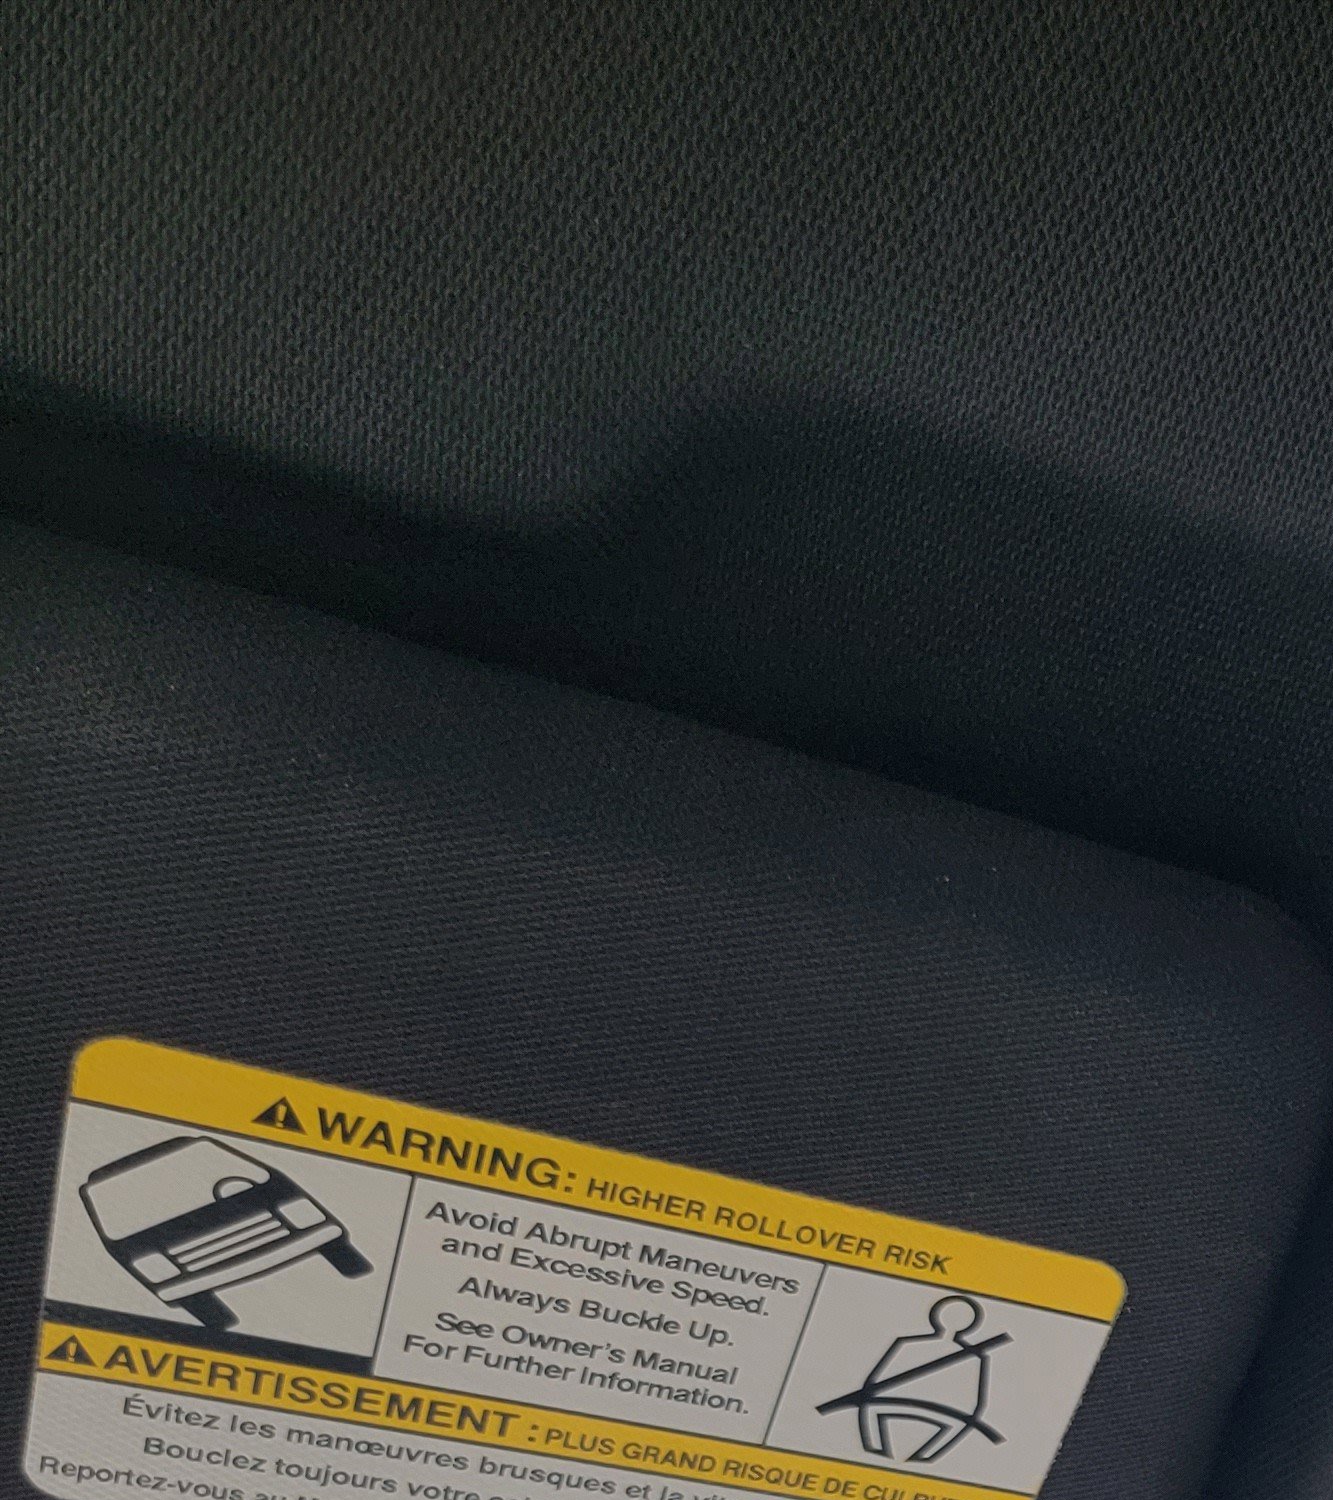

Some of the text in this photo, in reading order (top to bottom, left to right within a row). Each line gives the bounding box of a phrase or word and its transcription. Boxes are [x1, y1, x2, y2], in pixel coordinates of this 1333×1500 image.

[318, 1108, 951, 1274] WARNING: HIGHER ROLLOVER RISK
[425, 1201, 798, 1294] Avoid Abrupt Maneuvers
[440, 1237, 768, 1315] and Excessive Speed.
[434, 1311, 738, 1384] See Owner's Manual
[457, 1276, 733, 1347] Always Buckle Up.
[402, 1333, 747, 1413] For Further Information.
[105, 1346, 516, 1435] AVERTISSEMENT
[543, 1427, 615, 1455] PLUS
[621, 1441, 716, 1472] GRAND
[722, 1458, 818, 1491] RISQUE
[822, 1476, 859, 1498] DE
[122, 1392, 219, 1430] Évitez
[229, 1414, 275, 1439] les
[286, 1428, 468, 1470] manœuvres
[478, 1455, 615, 1494] brusques
[623, 1484, 651, 1500] et
[142, 1436, 266, 1472] Bouclez
[274, 1458, 396, 1493] toujours
